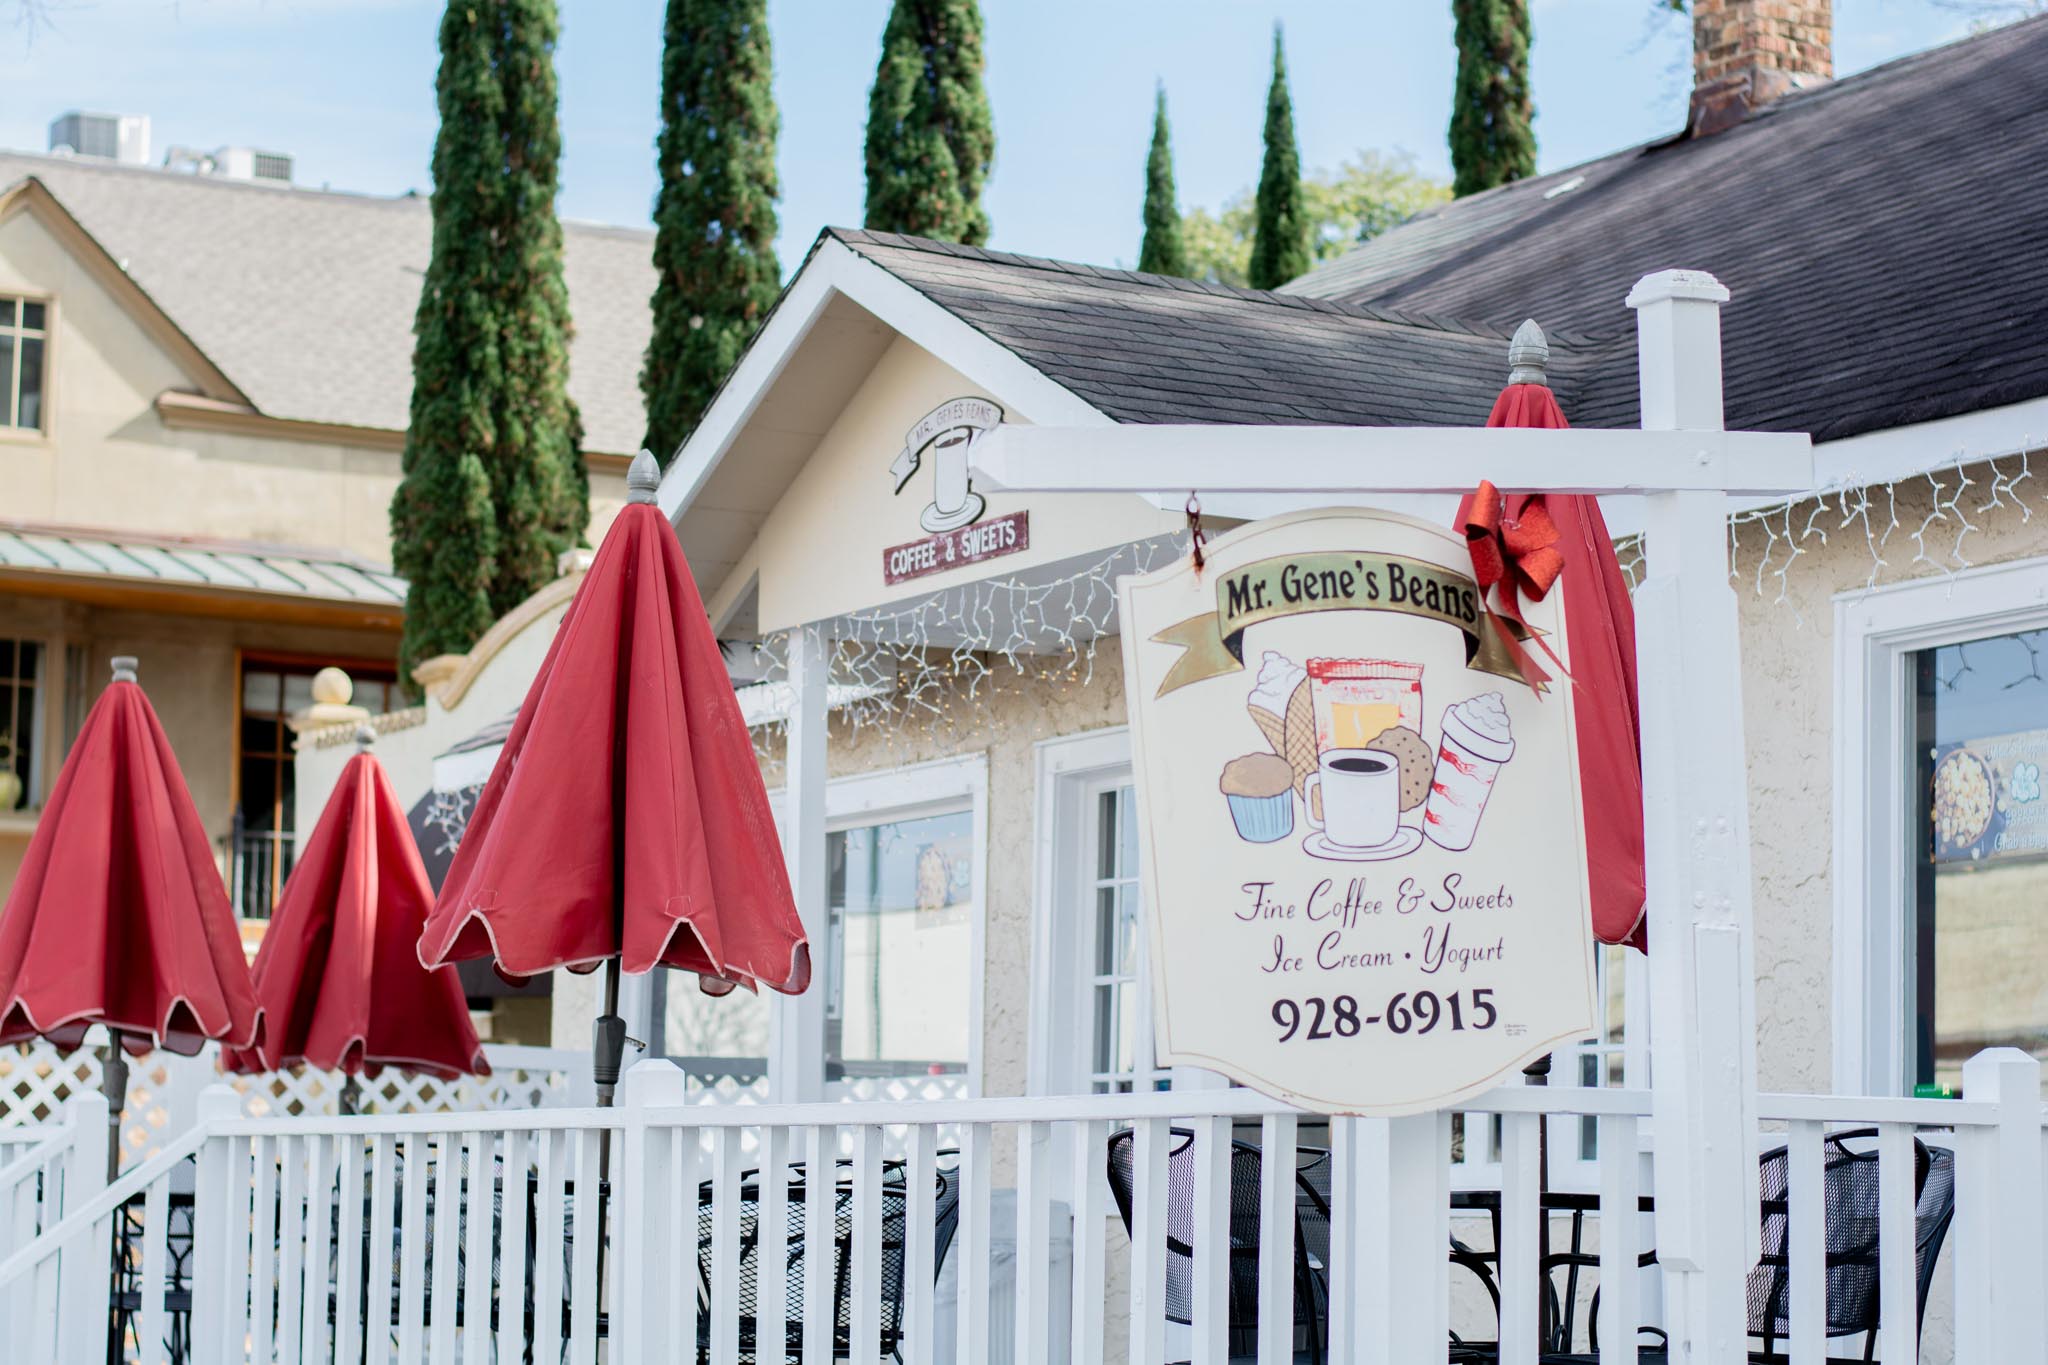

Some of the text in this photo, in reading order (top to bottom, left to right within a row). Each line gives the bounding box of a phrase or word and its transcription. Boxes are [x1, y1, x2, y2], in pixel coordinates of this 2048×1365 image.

[890, 519, 1016, 576] COFFEE & SWEETS
[1226, 560, 1476, 624] Mr. Gene's Beans
[1234, 873, 1513, 928] Fine Coffee & Sweets
[1261, 934, 1304, 973] Ice
[1316, 930, 1393, 970] Cream
[1420, 922, 1505, 973] Yogurt
[1271, 988, 1497, 1043] 928-6915
